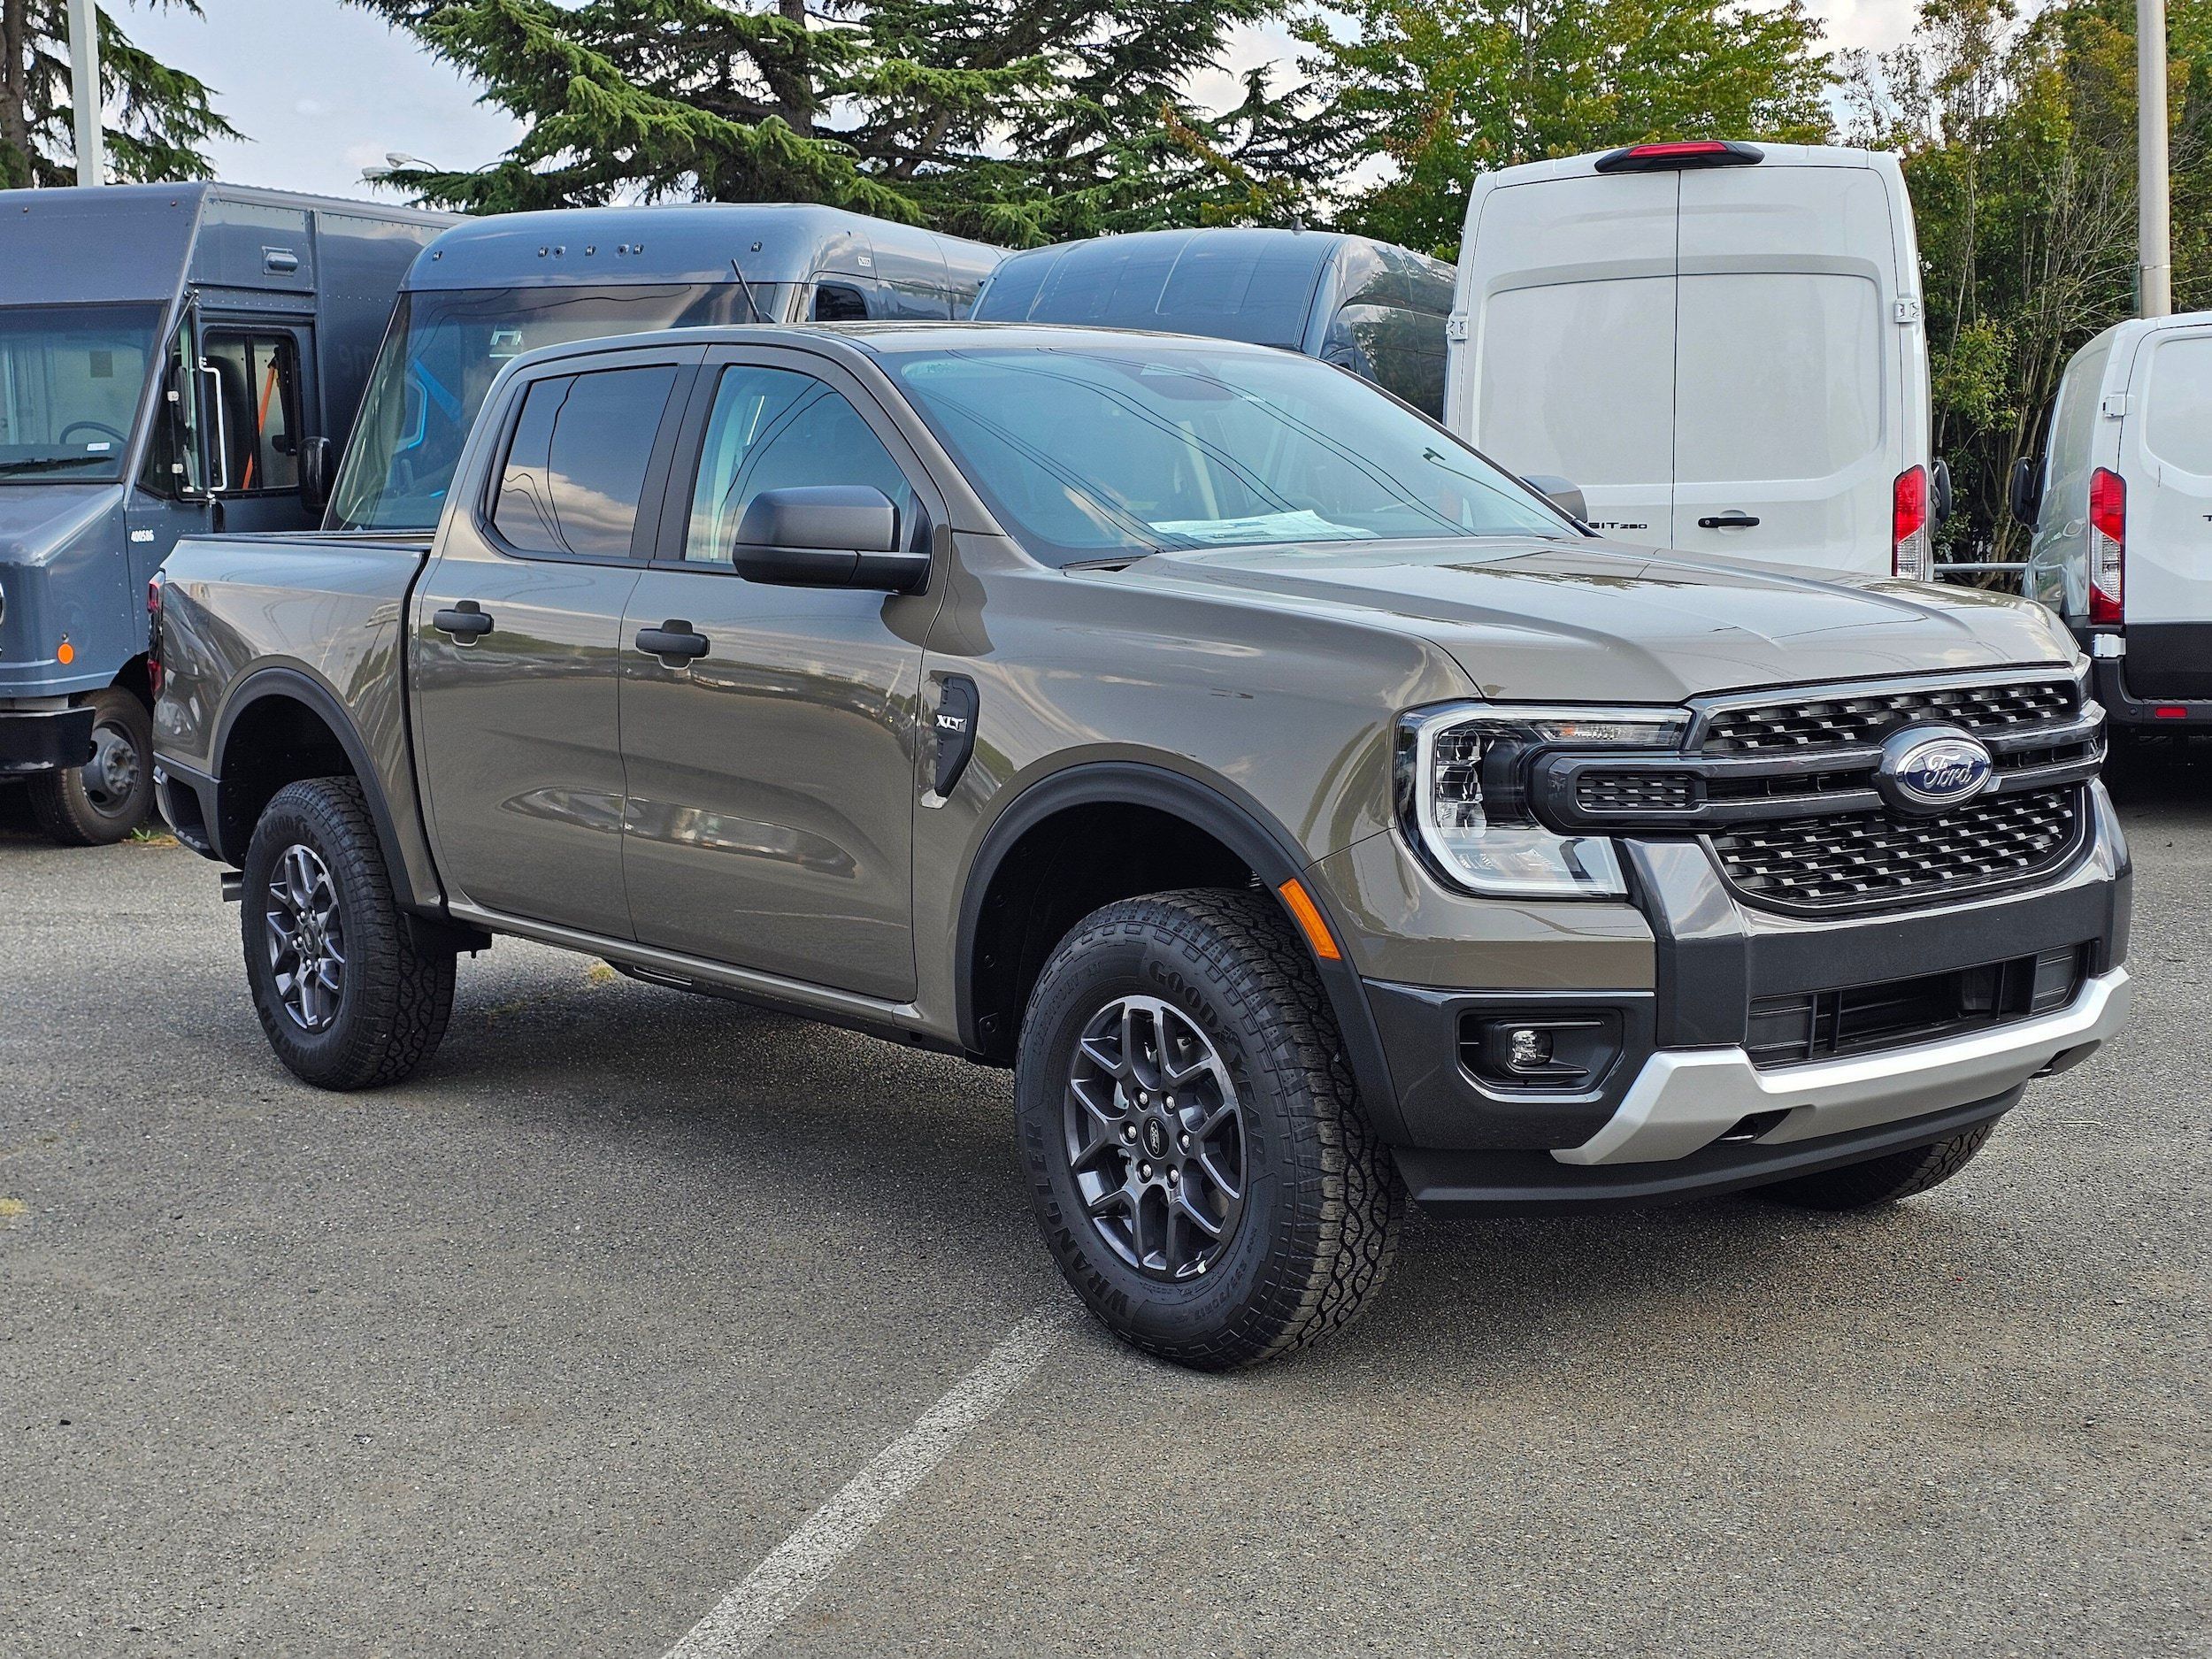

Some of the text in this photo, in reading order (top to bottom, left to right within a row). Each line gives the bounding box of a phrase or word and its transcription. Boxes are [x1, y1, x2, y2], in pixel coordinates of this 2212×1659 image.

[935, 714, 967, 731] XLT
[1924, 753, 1973, 789] Ford
[1149, 960, 1267, 1164] GOODYEAR
[1025, 1119, 1130, 1318] WRANGLER
